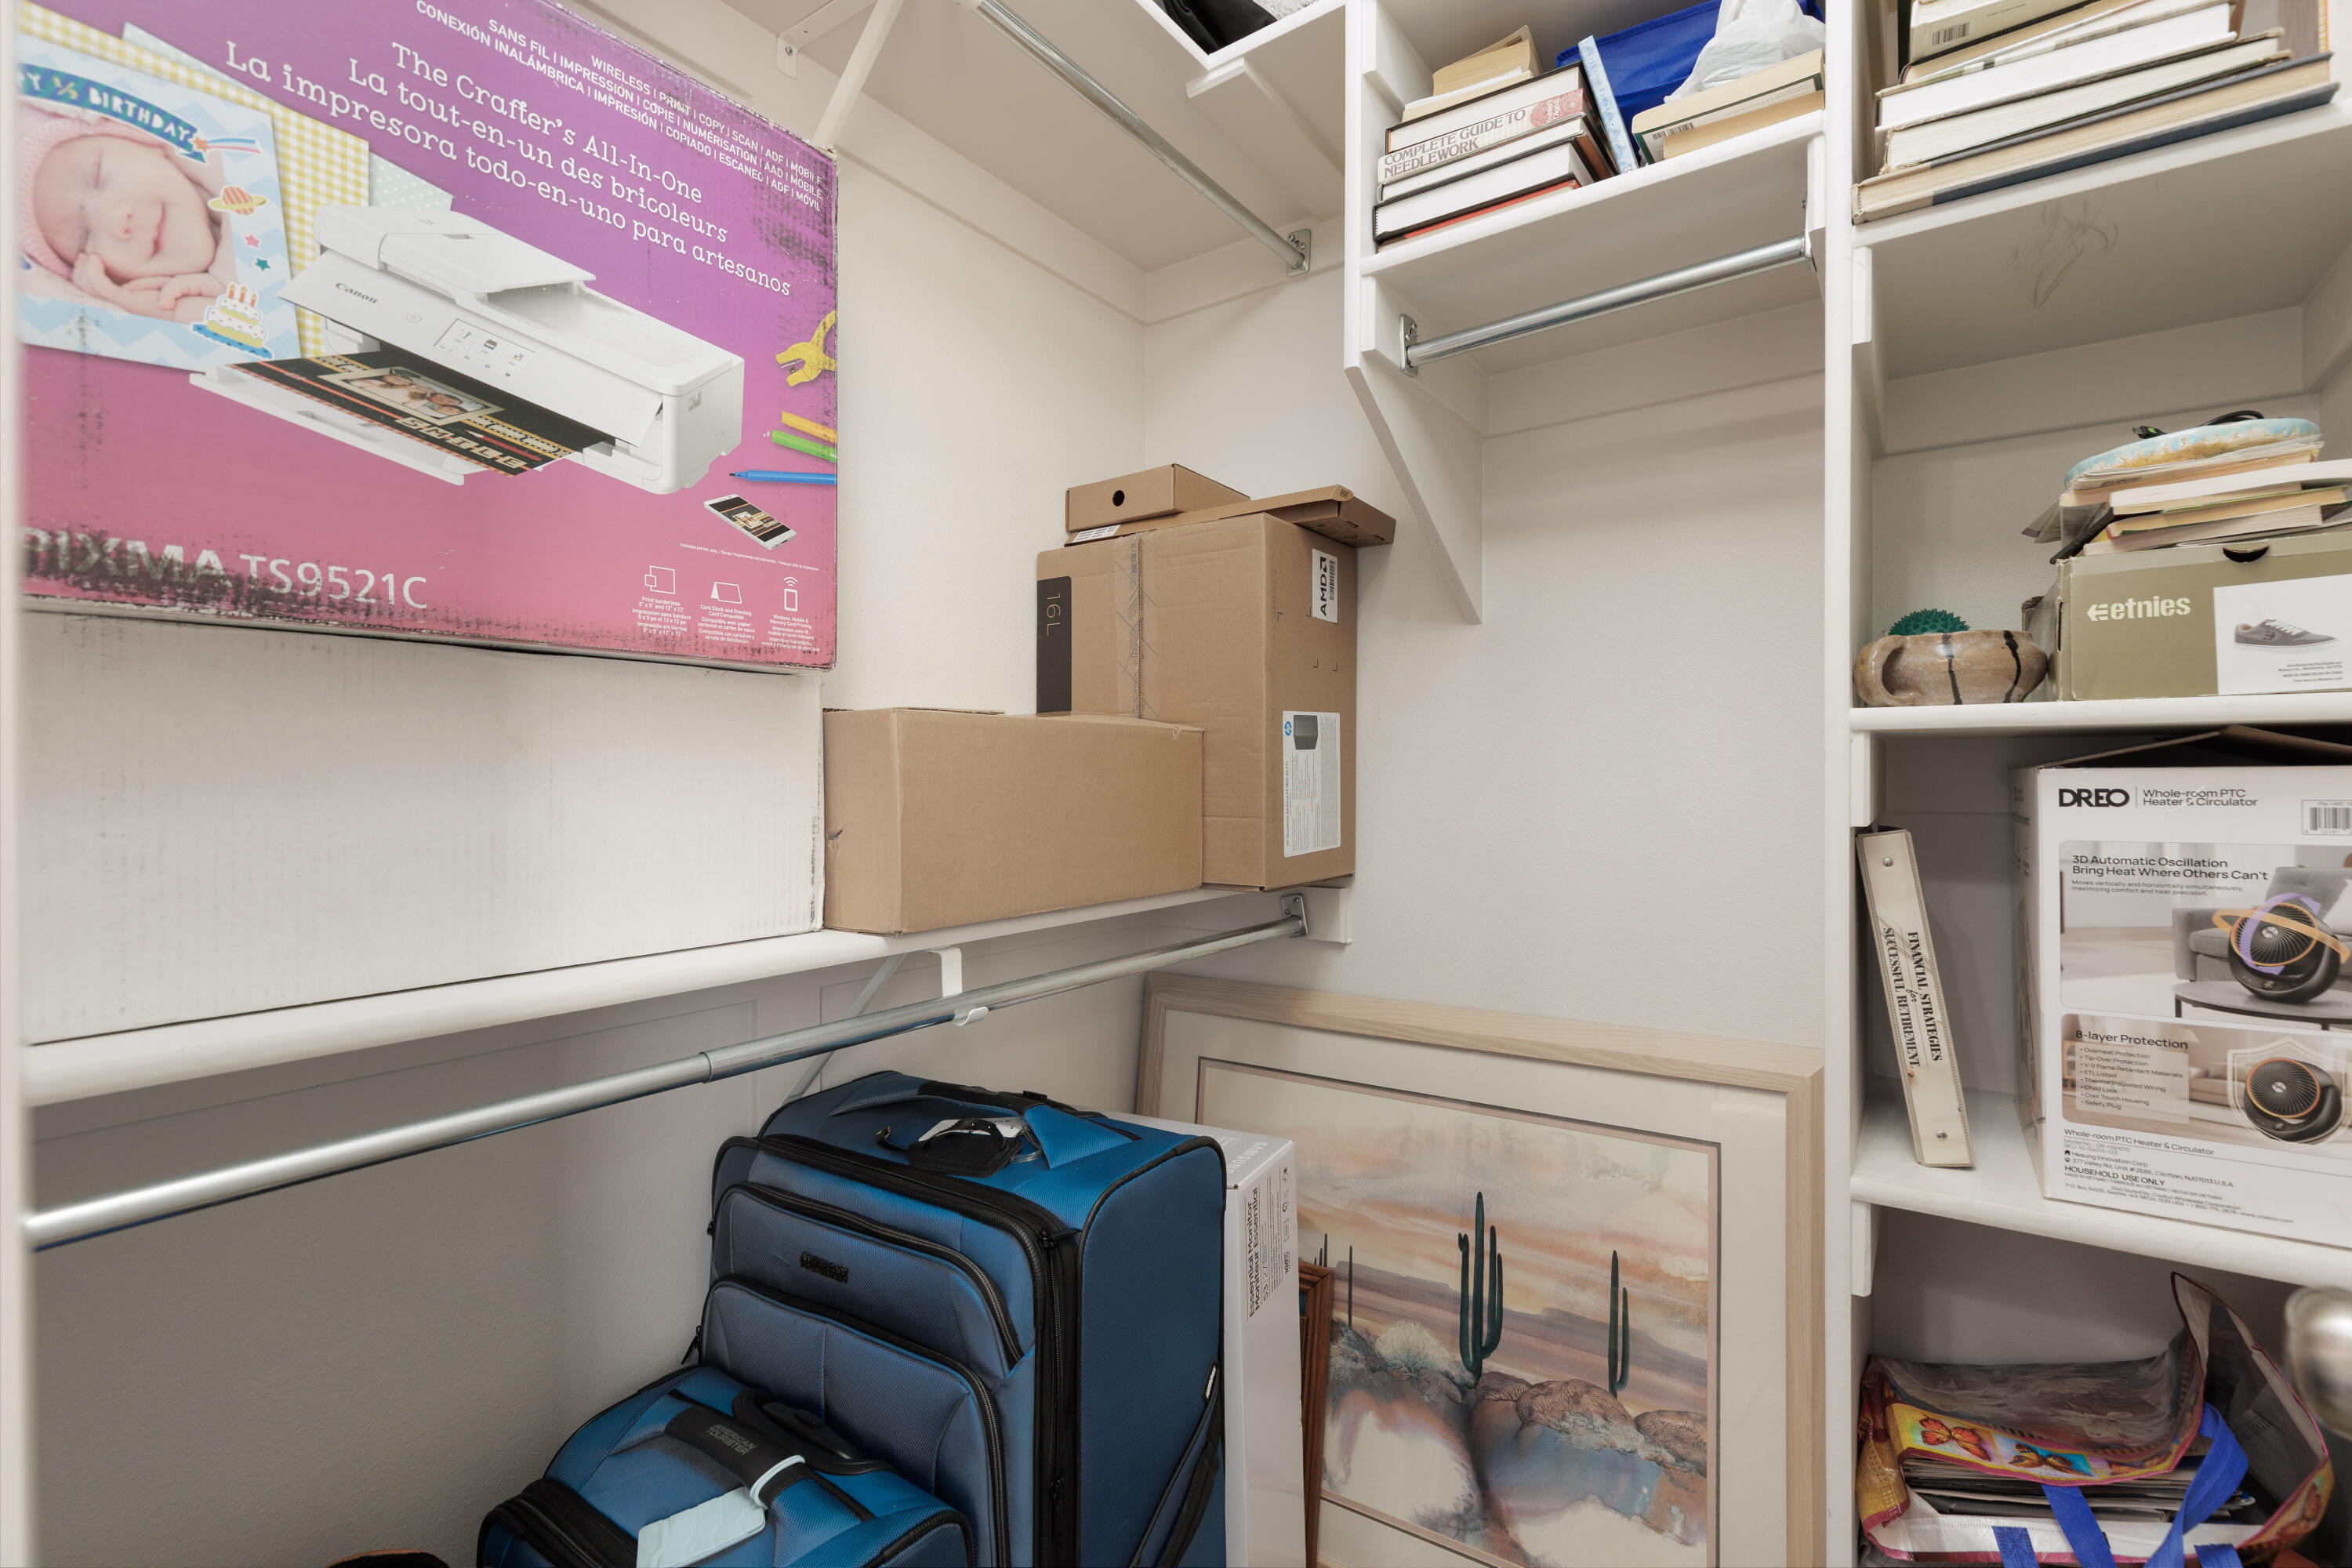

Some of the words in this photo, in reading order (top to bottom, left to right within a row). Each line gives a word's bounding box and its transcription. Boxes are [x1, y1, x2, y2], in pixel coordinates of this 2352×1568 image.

[89, 86, 191, 141] BIRTHDAY
[416, 0, 491, 47] CONEXIÓN
[495, 38, 585, 94] INALÁMBRICA
[593, 89, 657, 130] IMPRESIÓN
[666, 125, 711, 156] COPIADO
[719, 152, 764, 182] ESCANEO
[771, 180, 789, 196] ADF
[796, 191, 822, 212] MÓVIL
[489, 19, 526, 47] SANS
[530, 40, 550, 60] FIL
[643, 99, 675, 124] COPIE
[683, 118, 757, 165] NUMÉRISATION
[764, 162, 784, 178] AAD
[790, 174, 822, 199] MOBILE
[392, 42, 448, 87] The
[456, 74, 575, 147] Crafter's
[583, 135, 702, 204] All-In-One
[591, 55, 651, 95] WIRELESS
[659, 92, 691, 115] PRINT
[699, 113, 725, 132] COPY
[732, 130, 758, 151] SCAN
[765, 148, 784, 163] ADF
[790, 161, 822, 185] MOBILE
[1385, 133, 1457, 165] COMPLETE
[1459, 117, 1504, 140] GUIDE
[1506, 109, 1526, 124] TO
[349, 58, 388, 96] La
[397, 82, 554, 169] tout-en-un
[561, 157, 604, 189] des
[611, 176, 728, 243] bricoleurs
[1385, 137, 1480, 179] NEEDLEWORK
[226, 40, 271, 82] La
[282, 64, 457, 161] impresora
[466, 146, 626, 229] todo-en-uno
[632, 219, 687, 255] para
[691, 244, 791, 296] artesanos
[335, 282, 379, 304] Canon
[404, 418, 524, 467] SMILE
[21, 525, 234, 588] PIXMA
[239, 554, 428, 609] TS9521C
[1047, 592, 1061, 637] 16L
[2111, 596, 2190, 619] etnies
[1285, 721, 1292, 736] hp
[2058, 788, 2130, 808] DREO
[2143, 789, 2218, 798] Whole-room
[2220, 789, 2246, 797] PTC
[2143, 797, 2184, 806] Heater
[2186, 797, 2195, 806] &
[2195, 797, 2259, 807] Circulator
[2072, 855, 2089, 864] 3D
[2091, 856, 2157, 866] Automatic
[2158, 857, 2228, 868] Oscillation
[2072, 866, 2104, 877] Bring
[2106, 866, 2136, 877] Heat
[2138, 867, 2181, 877] Where
[2183, 869, 2228, 879] Others
[2230, 870, 2268, 880] Can't
[1883, 927, 1905, 993] SUCCESSFUL
[1897, 995, 1920, 1067] RETIREMENT
[1906, 989, 1918, 1003] for
[1907, 932, 1928, 989] FINANCIAL
[1920, 994, 1942, 1062] STRATEGIES
[2075, 1029, 2118, 1043] 8-layer
[2121, 1034, 2189, 1049] Protection
[2115, 1051, 2151, 1059] Protection
[2112, 1080, 2143, 1089] Insulated
[2151, 1069, 2183, 1078] Materials
[2084, 1099, 2107, 1108] Safety
[2122, 1097, 2150, 1106] Housing
[2063, 1128, 2114, 1142] Whole-room
[2115, 1135, 2132, 1144] PTC
[2133, 1138, 2161, 1148] Heater
[2171, 1143, 2215, 1155] Circulator
[2097, 1155, 2131, 1164] Innovation
[2064, 1166, 2118, 1178] HOUSEHOLD
[2140, 1177, 2165, 1185] ONLY
[706, 1427, 750, 1455] TOURISTER
[713, 1424, 757, 1450] AMERICAN
